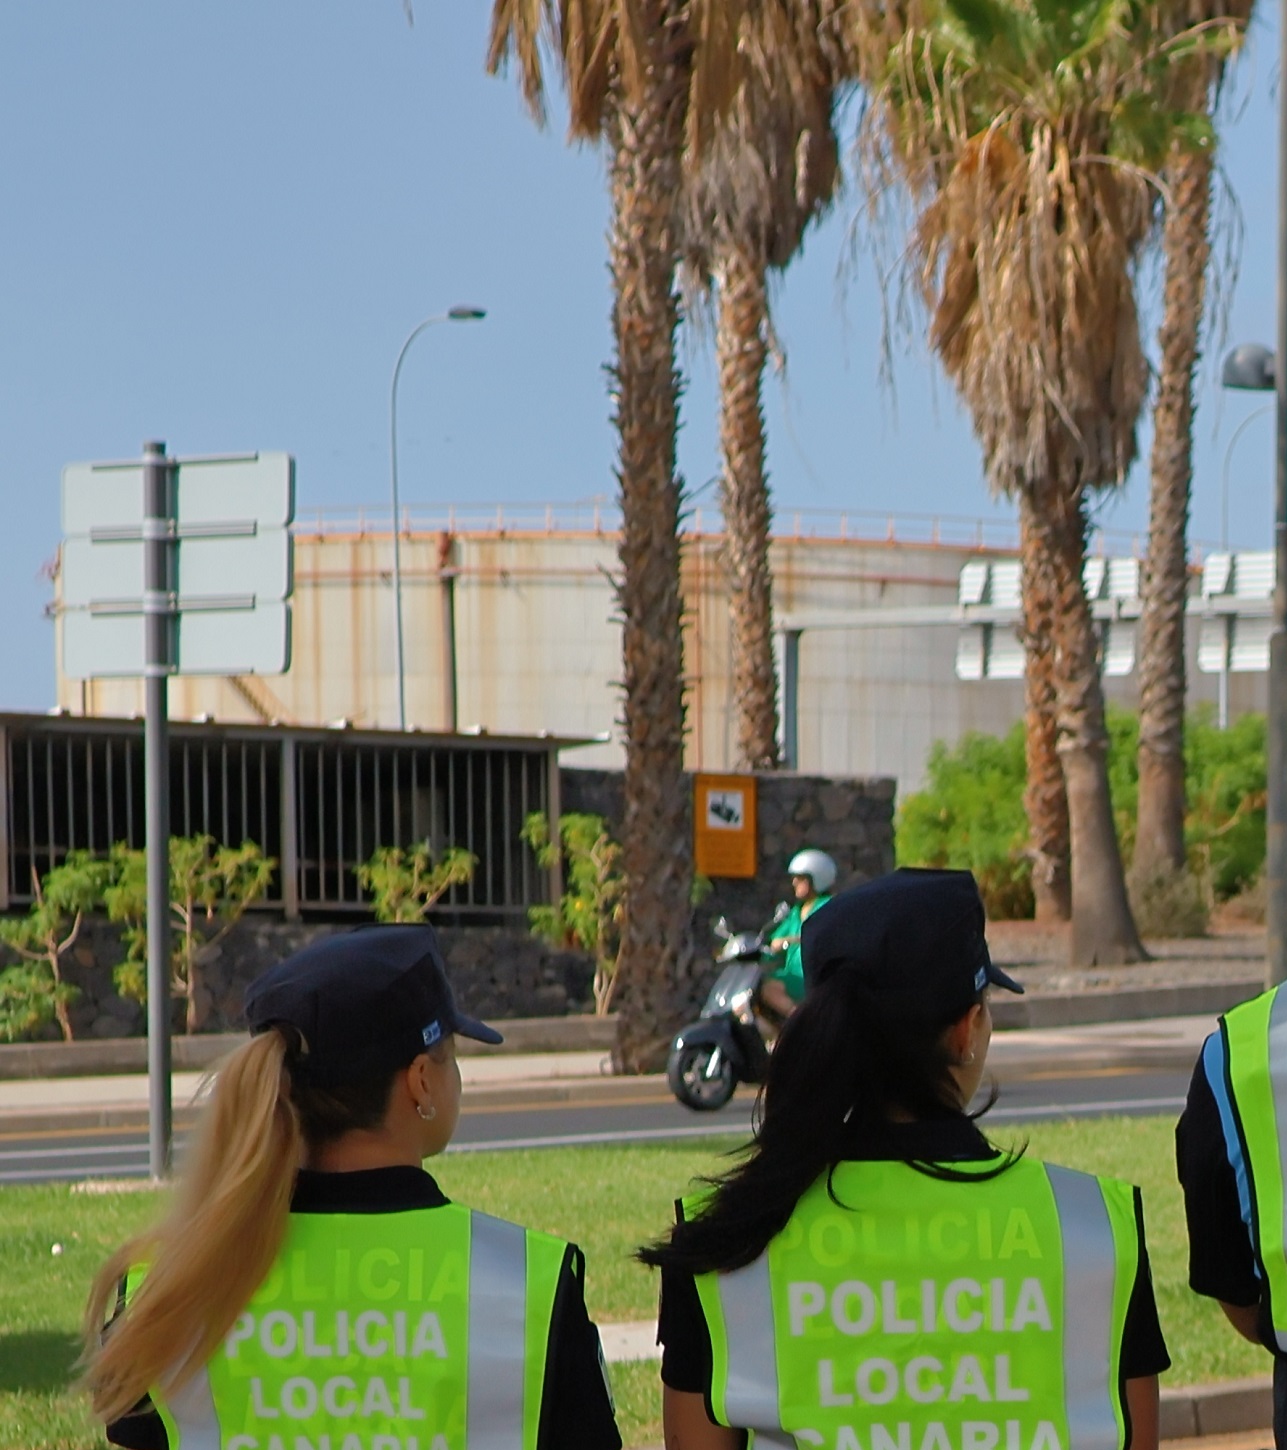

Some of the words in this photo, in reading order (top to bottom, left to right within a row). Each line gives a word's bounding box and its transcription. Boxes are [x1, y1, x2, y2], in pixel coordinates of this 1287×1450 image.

[787, 1277, 1053, 1337] POLICIA
[225, 1310, 448, 1359] POLICIA
[250, 1375, 425, 1419] LOCAL
[818, 1353, 1030, 1407] LOCAL
